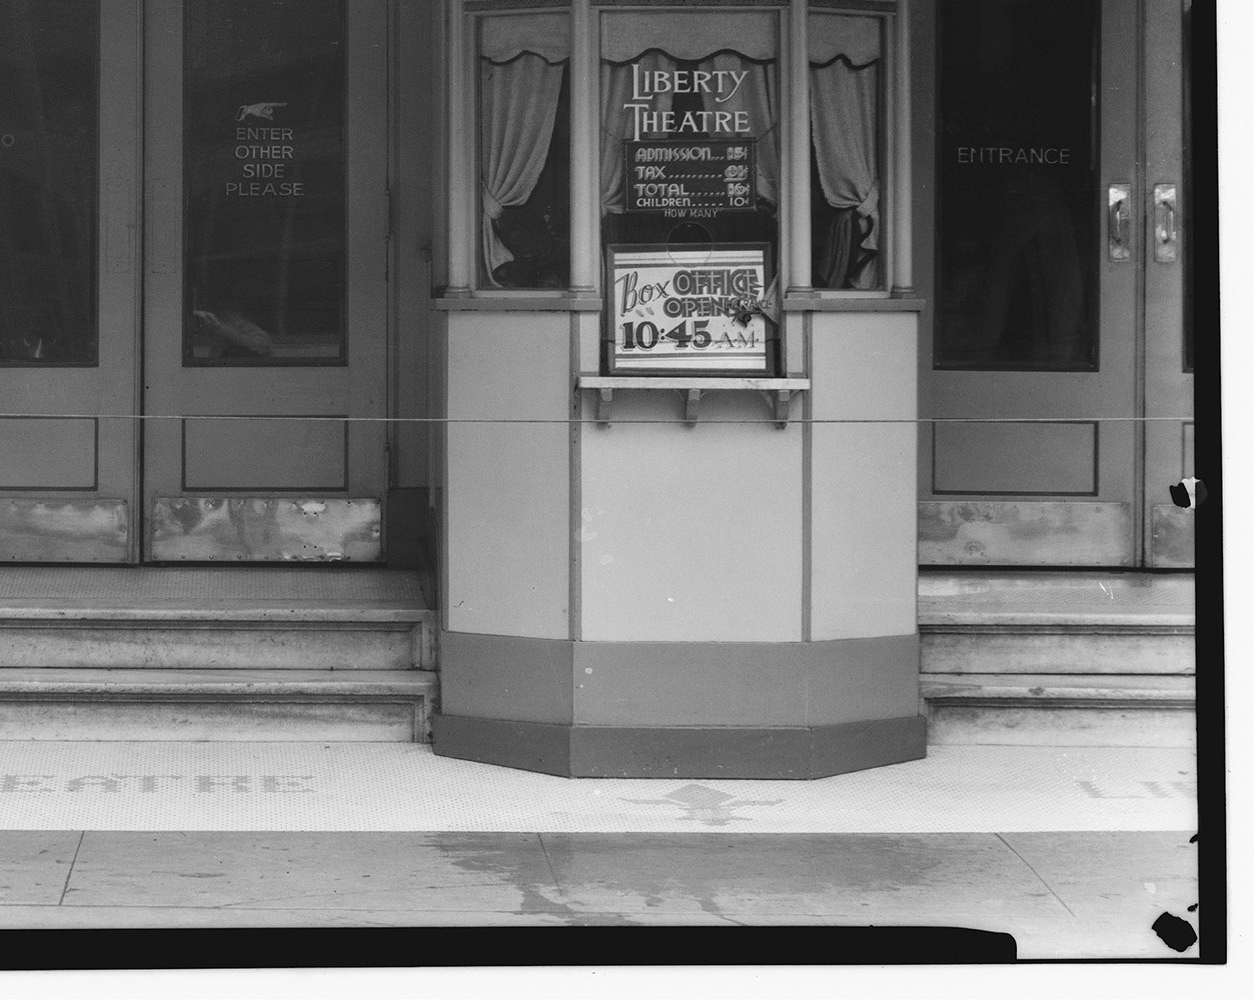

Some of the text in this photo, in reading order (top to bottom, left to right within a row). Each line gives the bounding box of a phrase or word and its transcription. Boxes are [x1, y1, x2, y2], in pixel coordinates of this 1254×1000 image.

[631, 63, 751, 102] LIBERTY
[623, 103, 751, 142] THEATRE
[236, 127, 294, 141] ENTER
[234, 145, 294, 159] OTHER
[956, 146, 1071, 165] ENTRANCE
[242, 163, 285, 178] SIDE
[226, 182, 305, 197] PLEASE
[614, 268, 763, 318] Box OFFICE
[619, 319, 712, 351] 10:45
